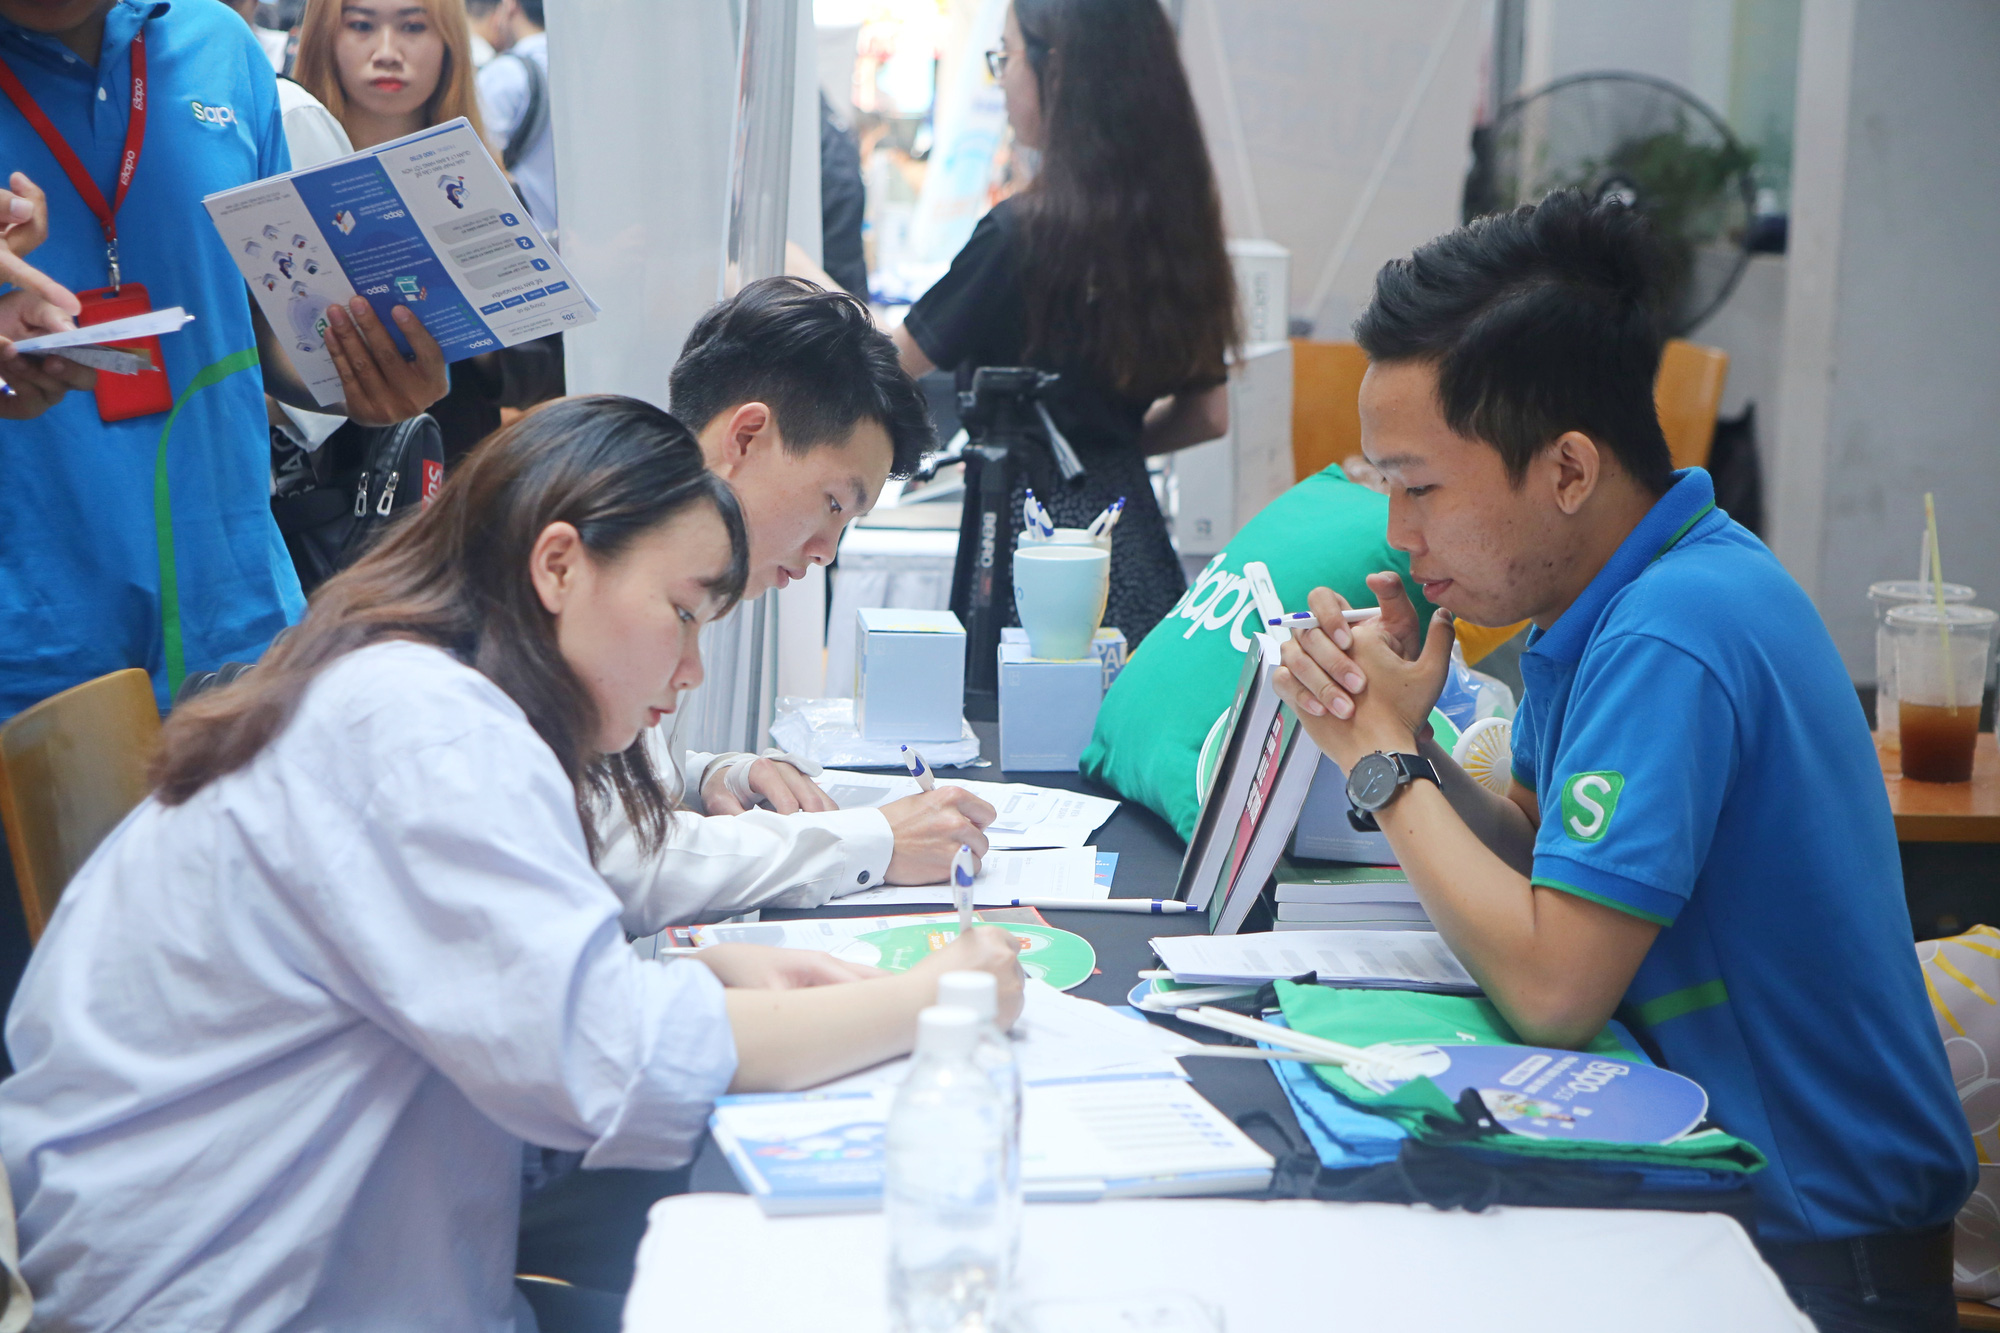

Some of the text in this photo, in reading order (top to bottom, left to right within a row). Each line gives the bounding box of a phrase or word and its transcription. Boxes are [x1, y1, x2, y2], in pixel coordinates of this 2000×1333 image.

[504, 214, 513, 224] 3
[520, 238, 529, 248] 2
[537, 259, 544, 268] 1
[561, 311, 576, 322] 30s
[1569, 775, 1611, 837] S
